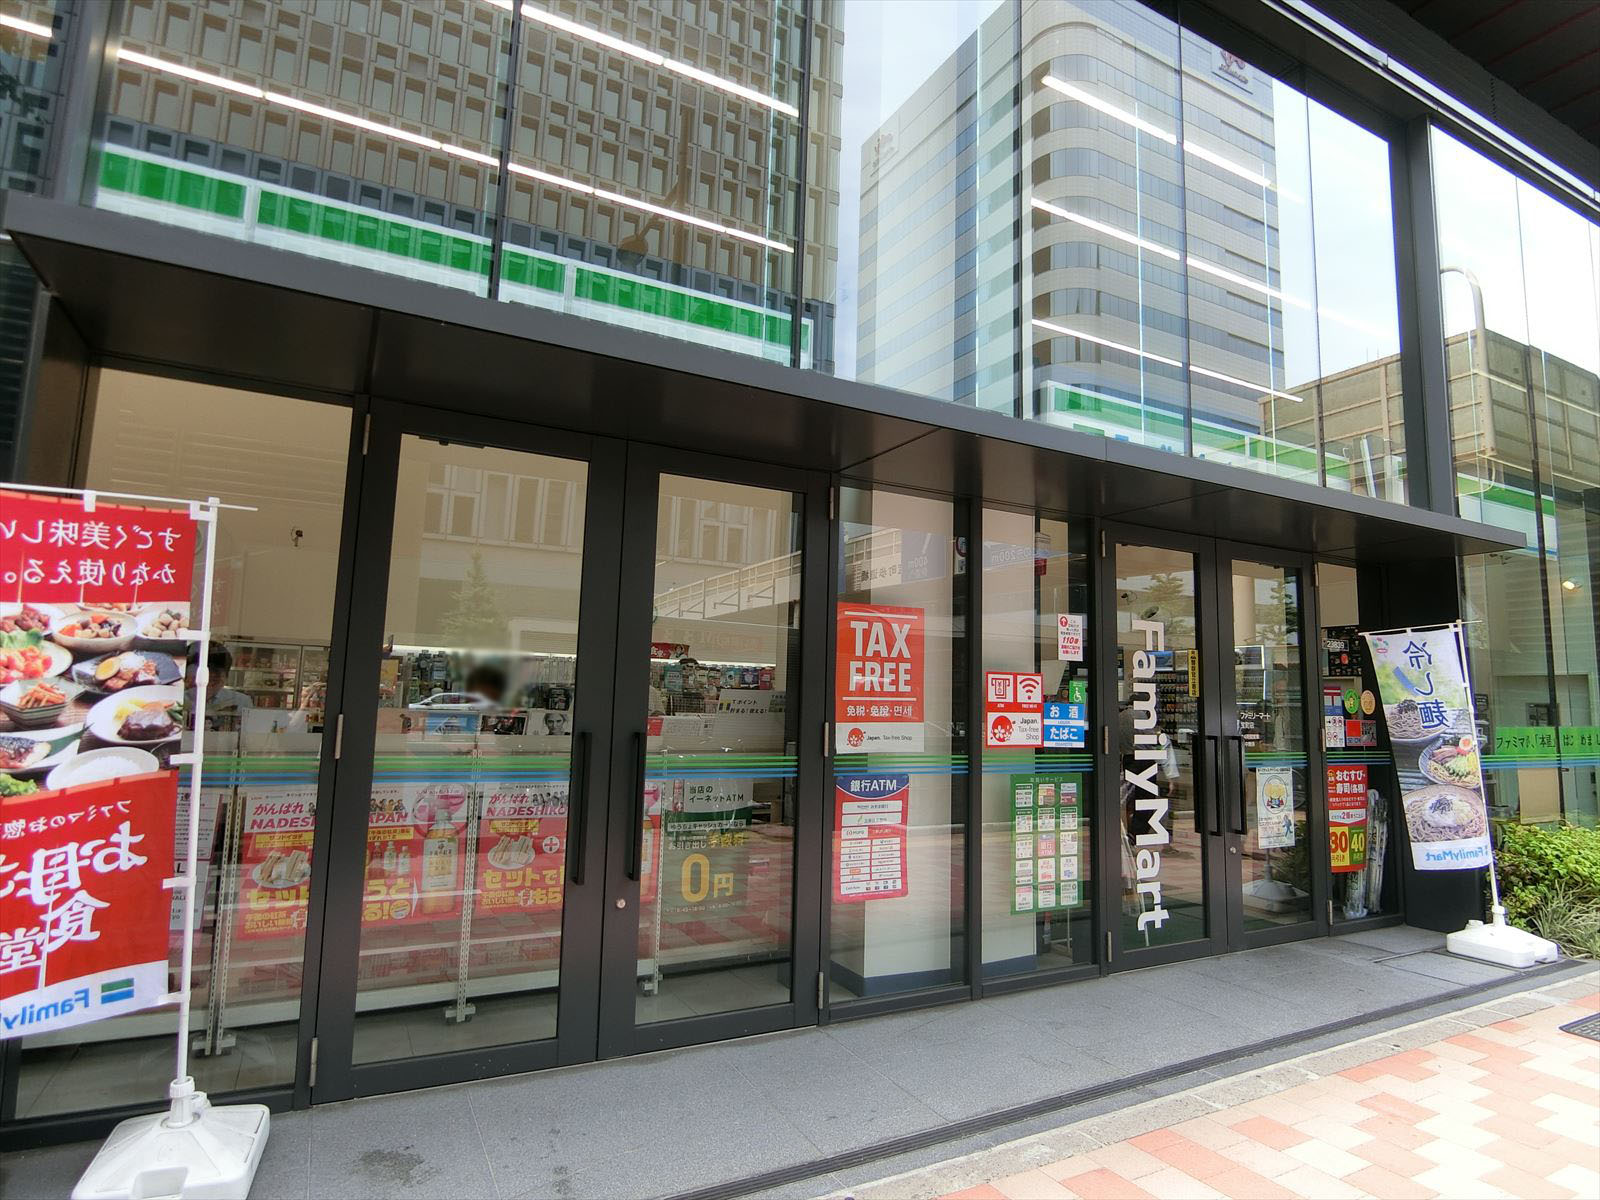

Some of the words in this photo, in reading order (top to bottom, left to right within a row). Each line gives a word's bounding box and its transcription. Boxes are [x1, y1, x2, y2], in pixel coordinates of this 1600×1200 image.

[850, 621, 912, 658] TAX
[849, 661, 912, 692] FREE
[1049, 705, 1079, 718] お酒
[1240, 712, 1271, 720] ファミリーマート
[1025, 733, 1039, 741] Shop
[1049, 727, 1079, 740] たばこ
[1125, 620, 1170, 931] FamilyMart
[689, 785, 714, 795] 当店の
[850, 779, 897, 792] 銀行ATM
[689, 794, 744, 803] イーネットATM
[253, 801, 305, 815] がんばれ
[368, 811, 408, 824] APAN
[1330, 831, 1348, 853] 30
[1351, 833, 1365, 852] 40
[681, 853, 734, 902] 0円
